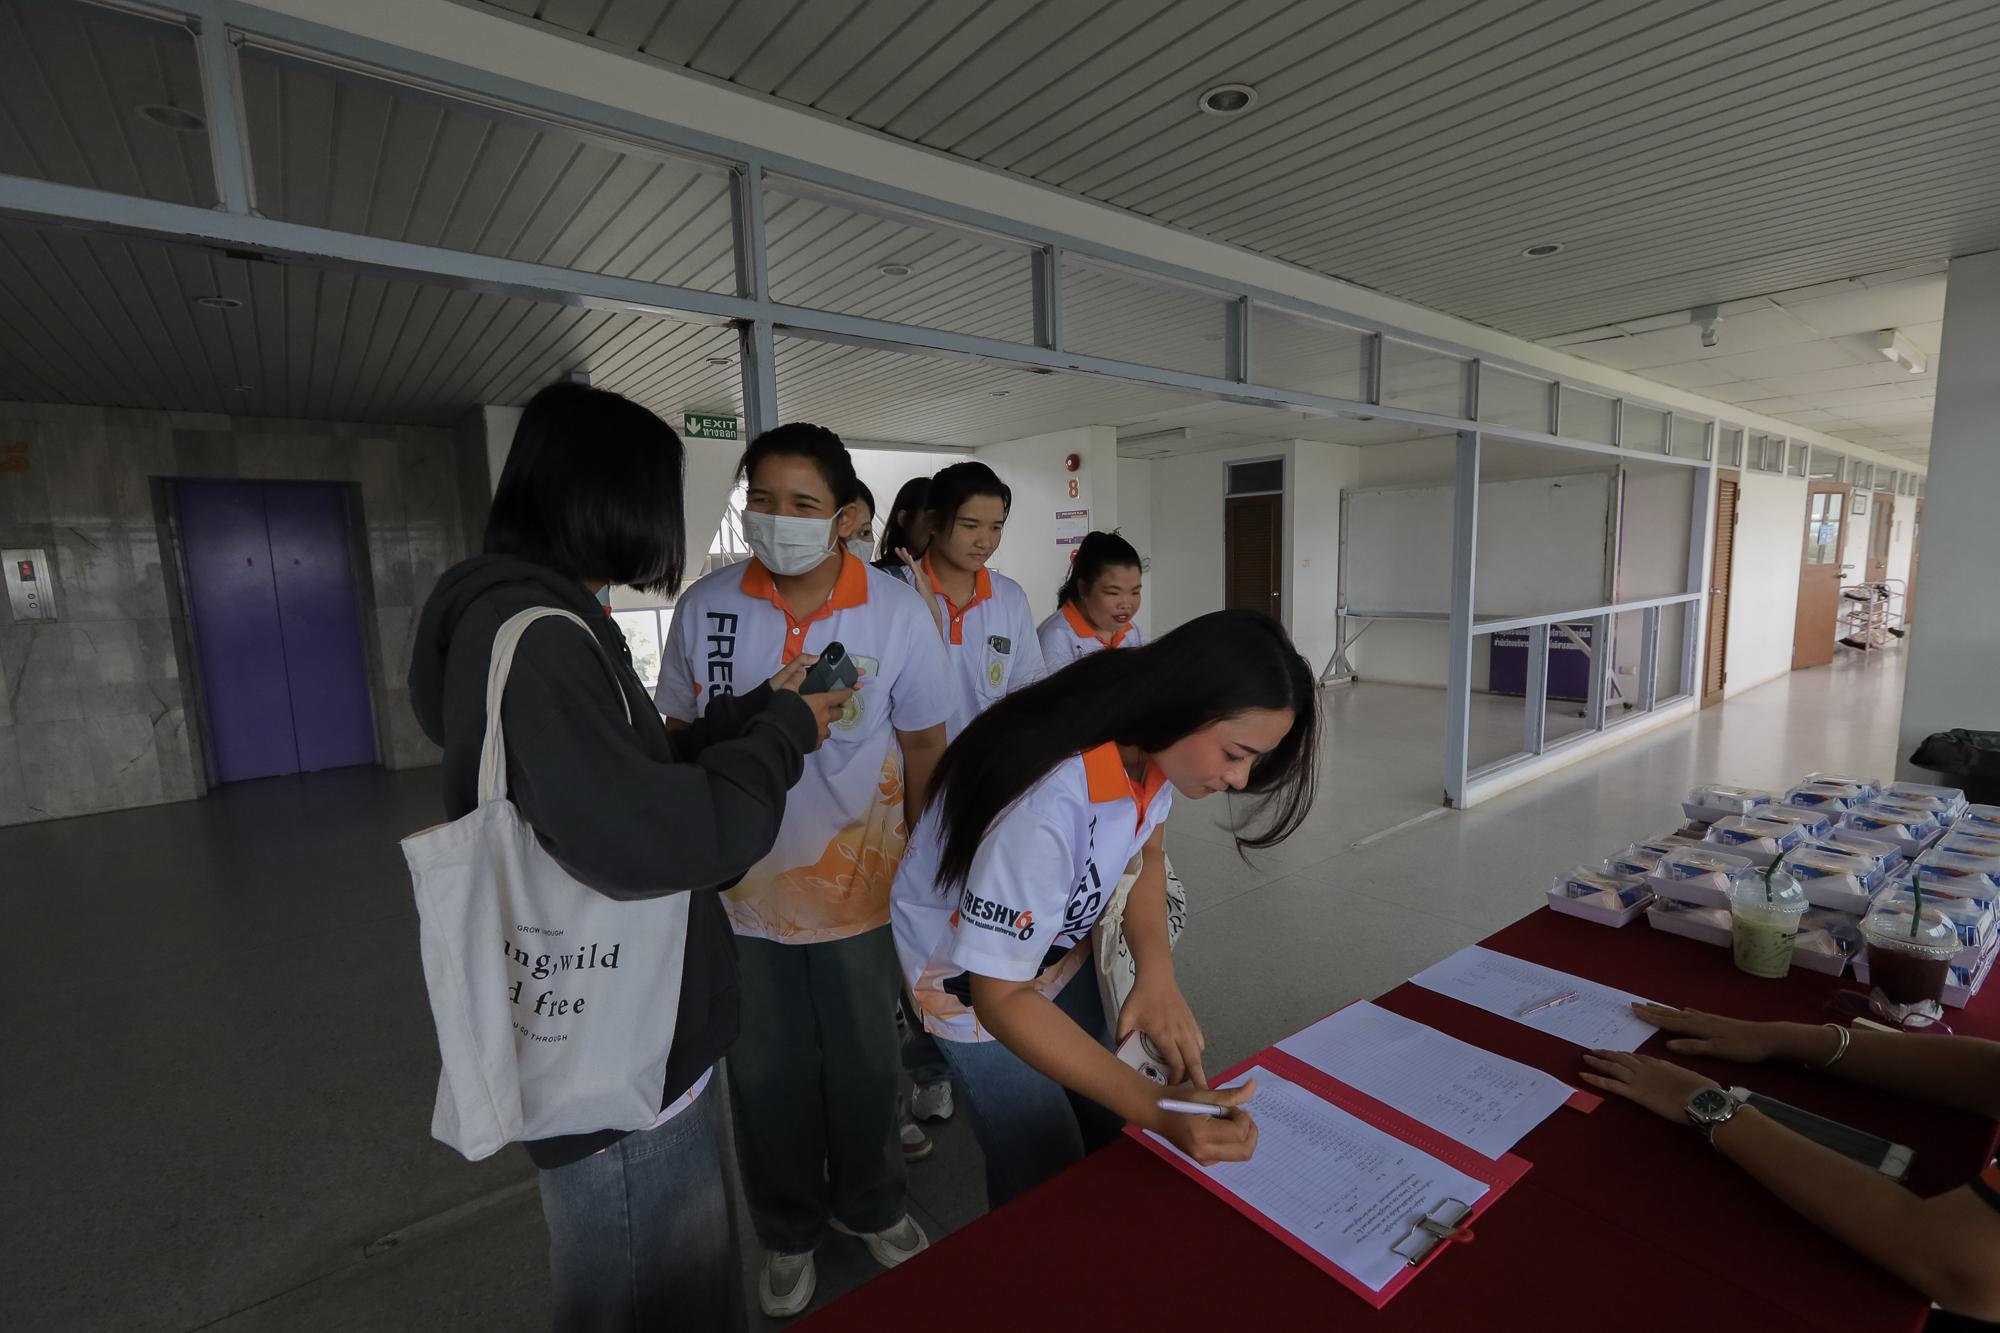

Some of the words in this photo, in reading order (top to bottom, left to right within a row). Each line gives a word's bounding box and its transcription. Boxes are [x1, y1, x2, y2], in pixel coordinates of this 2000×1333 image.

[703, 419, 735, 429] EXIT
[703, 427, 736, 438] ทางออก
[1069, 479, 1078, 498] 8
[517, 924, 540, 934] GROW
[534, 990, 585, 1017] free
